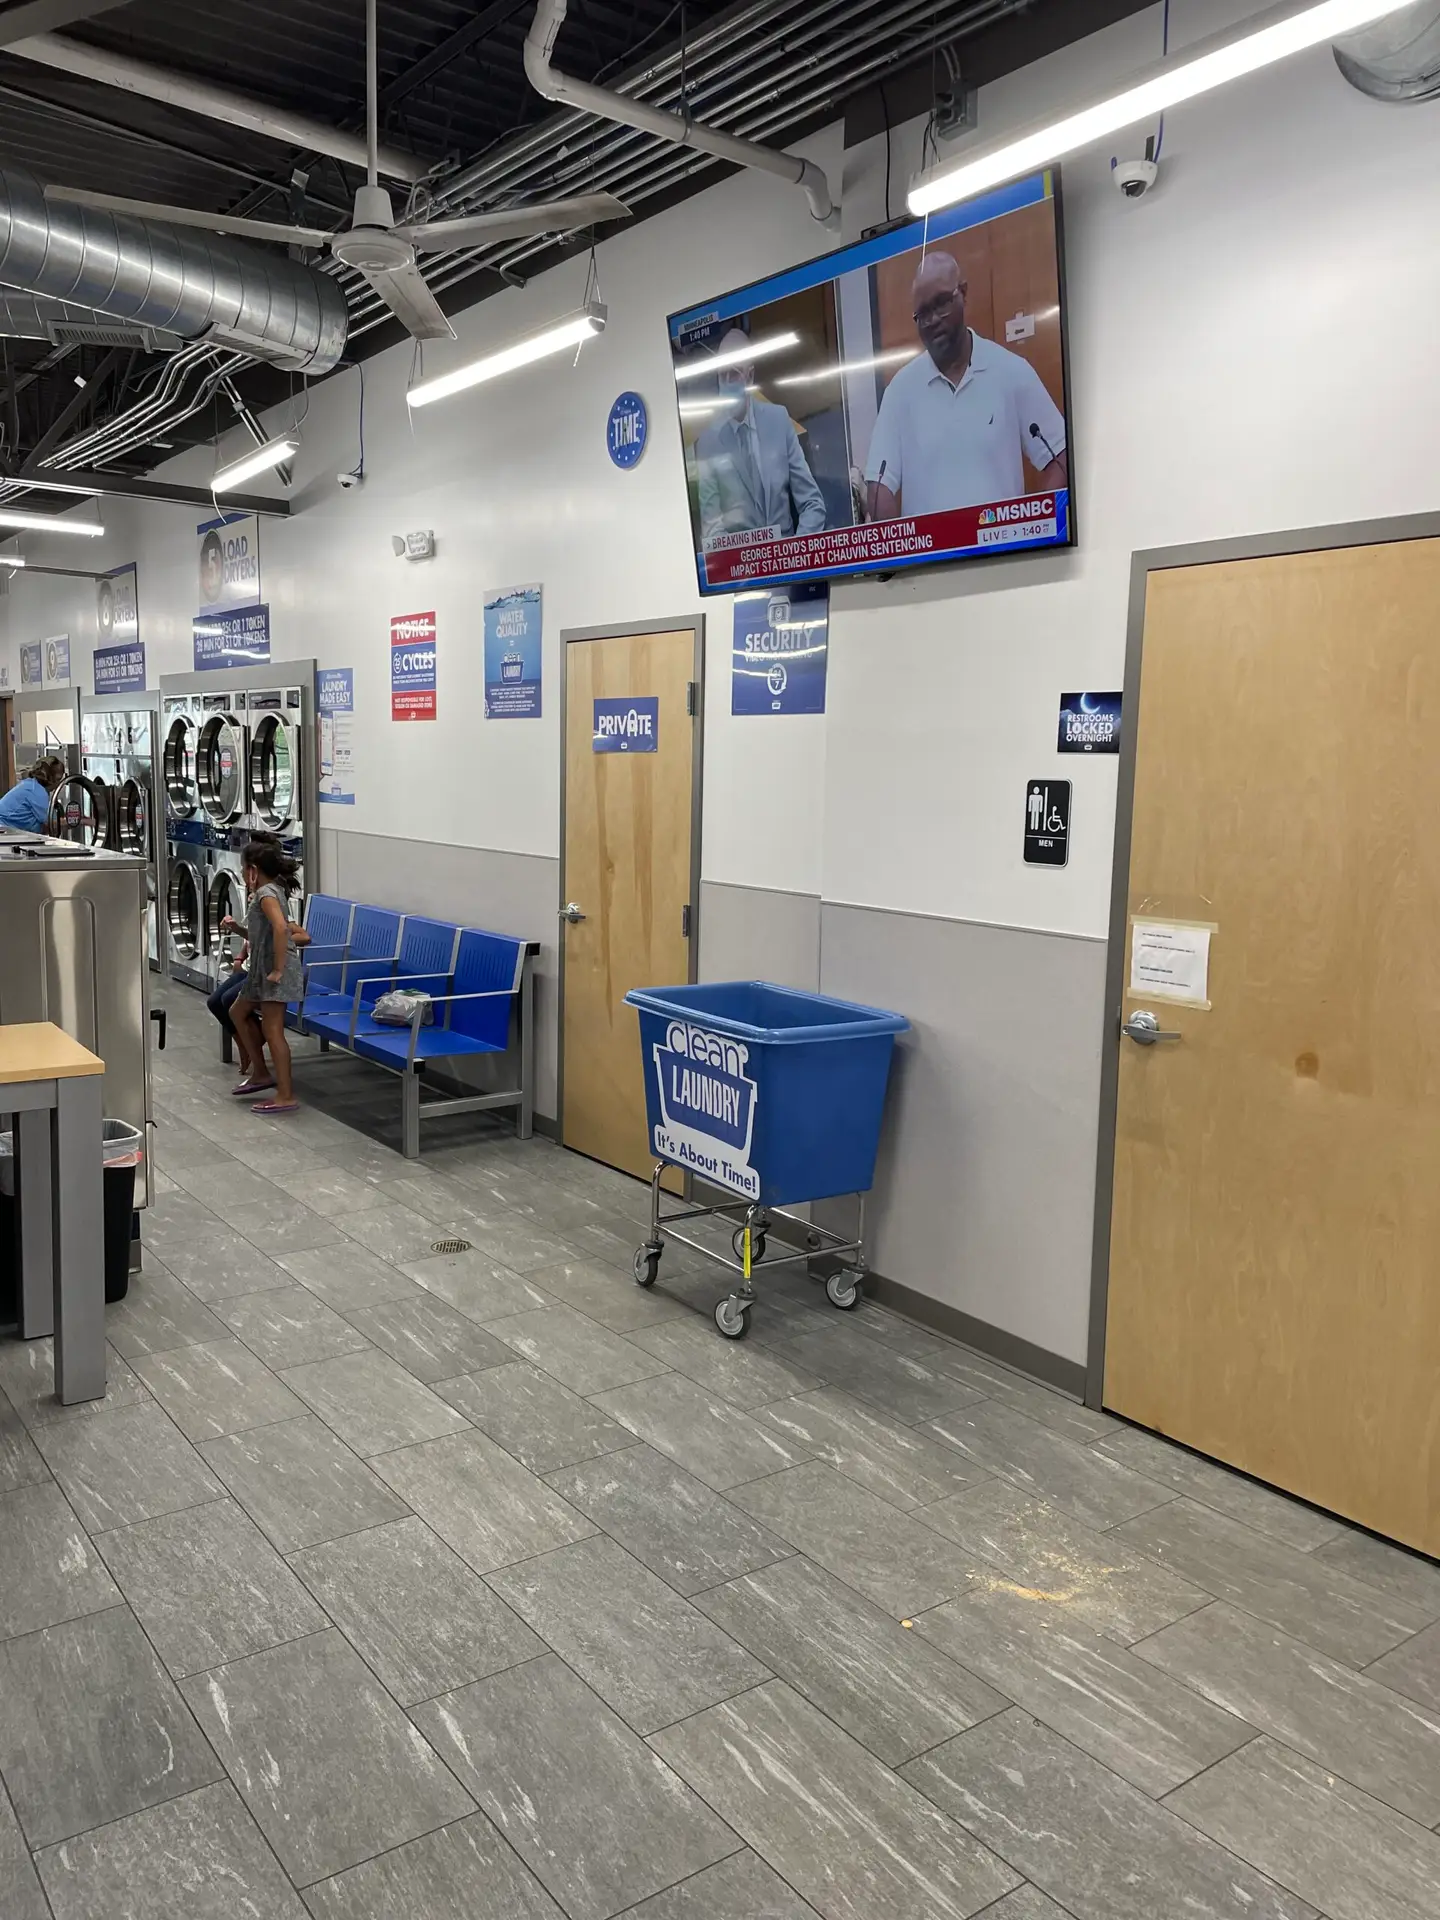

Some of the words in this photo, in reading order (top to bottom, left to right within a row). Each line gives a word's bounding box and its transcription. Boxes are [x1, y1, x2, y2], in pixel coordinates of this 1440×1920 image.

[701, 326, 710, 338] PM
[612, 410, 640, 447] TIME
[996, 498, 1053, 522] MSNBC
[712, 534, 749, 550] BREAKING
[751, 528, 774, 543] NEWS
[740, 546, 772, 562] GEORGE
[773, 540, 807, 557] FLOYD'S
[808, 533, 849, 552] BROTHER
[851, 528, 878, 545] GIVES
[880, 521, 916, 540] VICTIM
[983, 530, 1008, 542] LIVE
[1022, 525, 1041, 536] 1:40
[223, 536, 248, 562] LOAD
[730, 562, 760, 577] IMPACT
[762, 554, 811, 573] STATEMENT
[813, 552, 825, 565] AT
[827, 545, 869, 563] CHAUVIN
[870, 534, 933, 556] SENTENCING
[224, 555, 256, 584] DRYERS
[232, 619, 241, 633] OR
[246, 614, 265, 630] TOKEN
[499, 609, 524, 624] WATER
[204, 637, 214, 651] MIN
[214, 636, 225, 650] FOR
[233, 634, 242, 647] OR
[243, 629, 266, 646] TOKENS
[396, 618, 430, 640] NOTICE
[496, 621, 528, 638] QUALITY
[745, 628, 814, 653] SECURITY
[402, 651, 434, 672] CYCLES
[775, 680, 780, 689] 7
[335, 691, 351, 704] EASY
[598, 709, 652, 737] PRIVATE
[1066, 722, 1113, 734] LOCKED
[1067, 714, 1114, 722] RESTROOMS
[1066, 733, 1113, 742] OVERNIGHT
[1038, 839, 1054, 848] MEN
[669, 1023, 740, 1077] clean
[672, 1064, 740, 1127] LAUNDRY
[657, 1131, 675, 1153] It's
[679, 1142, 718, 1174] About
[721, 1161, 757, 1194] Time!
